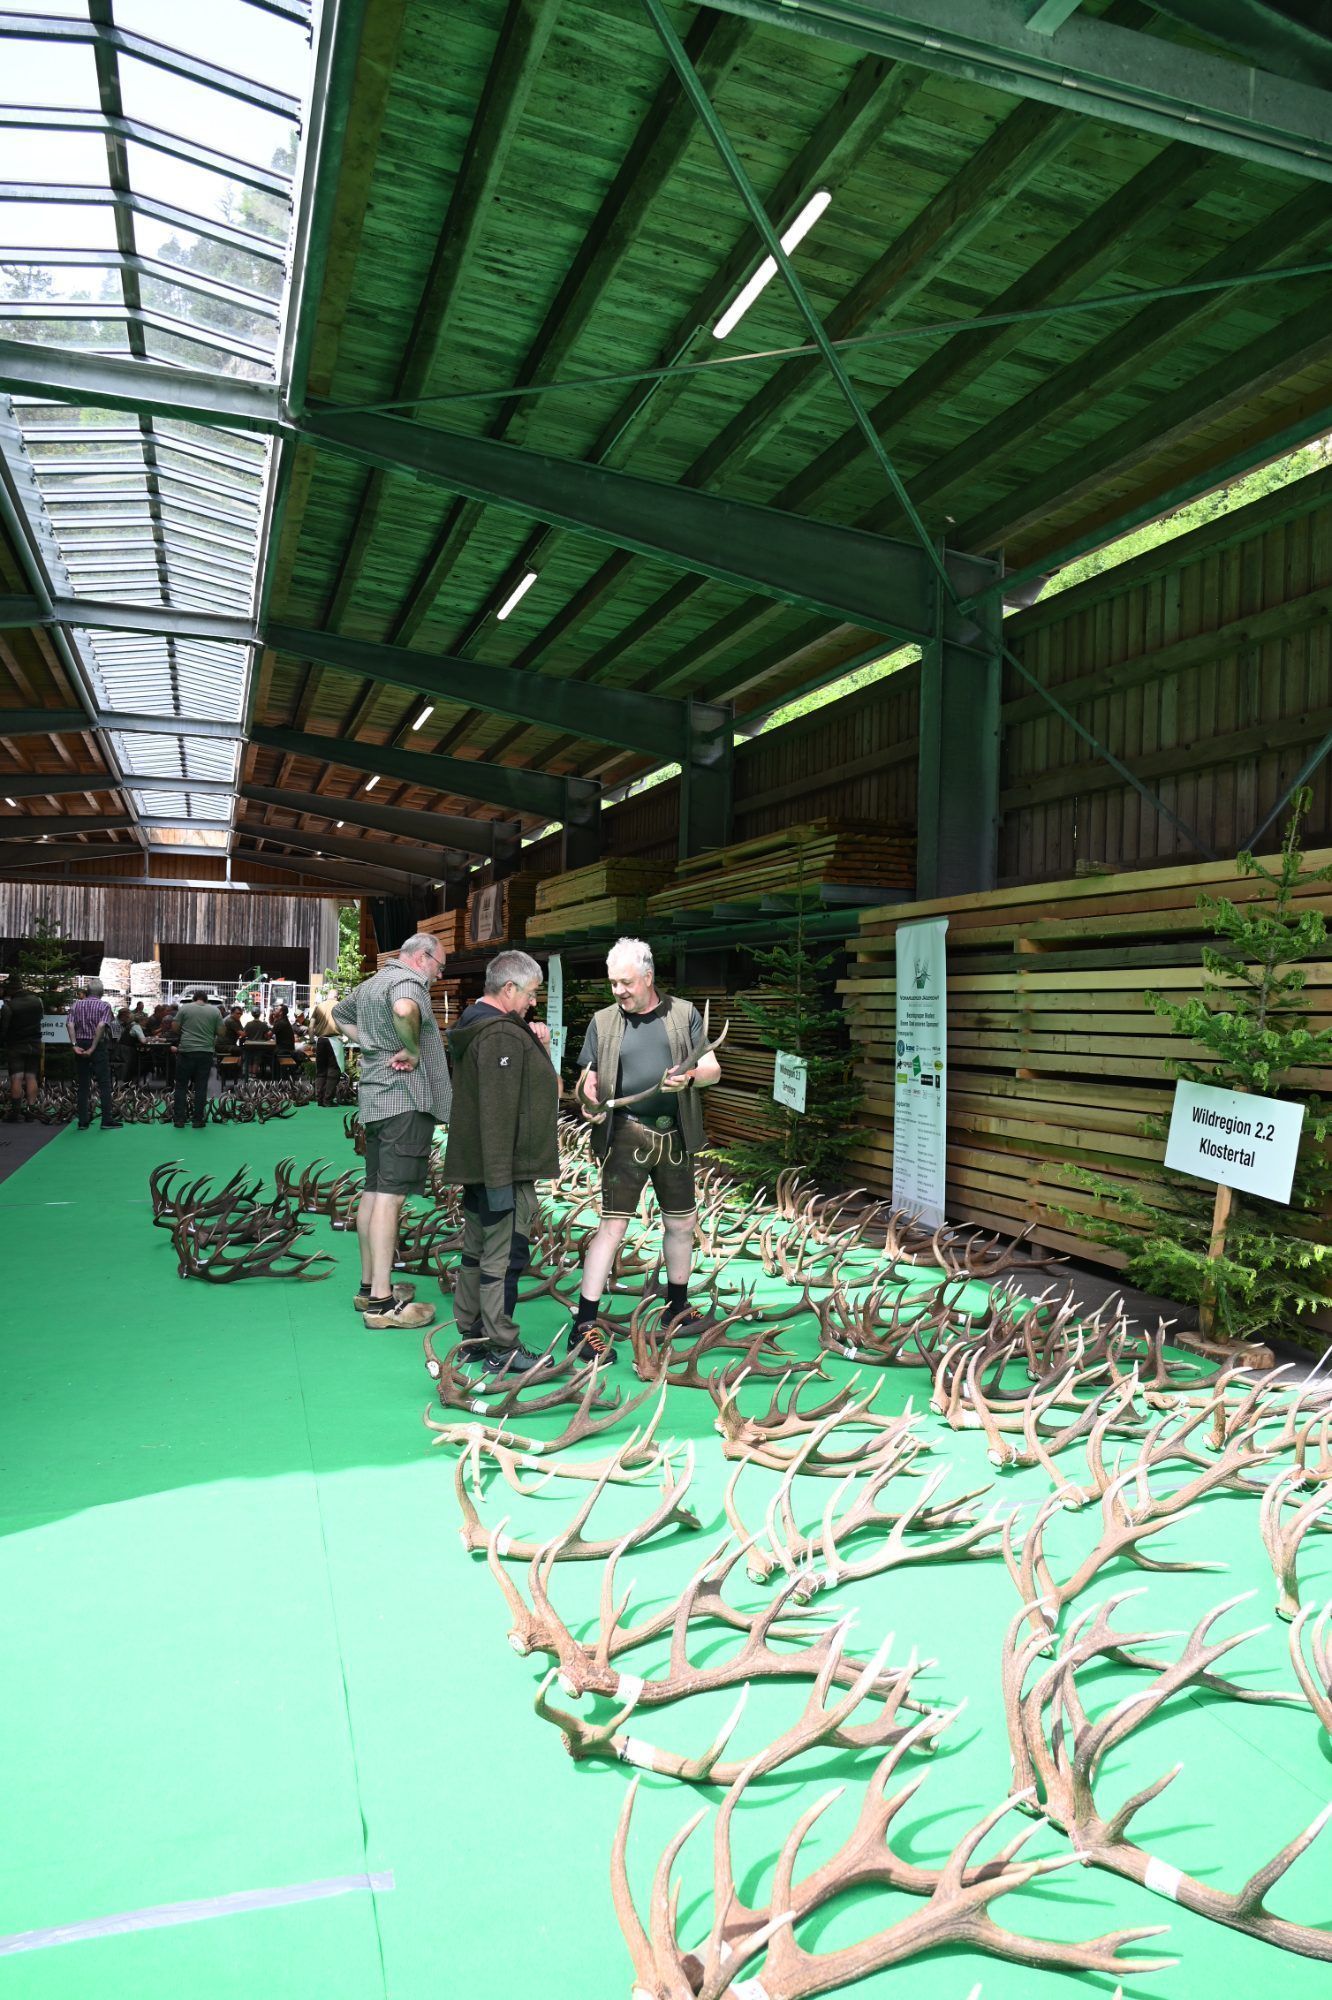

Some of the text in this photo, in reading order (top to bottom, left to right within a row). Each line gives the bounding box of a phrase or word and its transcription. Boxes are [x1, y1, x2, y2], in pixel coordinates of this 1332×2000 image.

[1192, 1106, 1275, 1141] Wildregion 2.2
[1199, 1137, 1256, 1167] Klostertal
